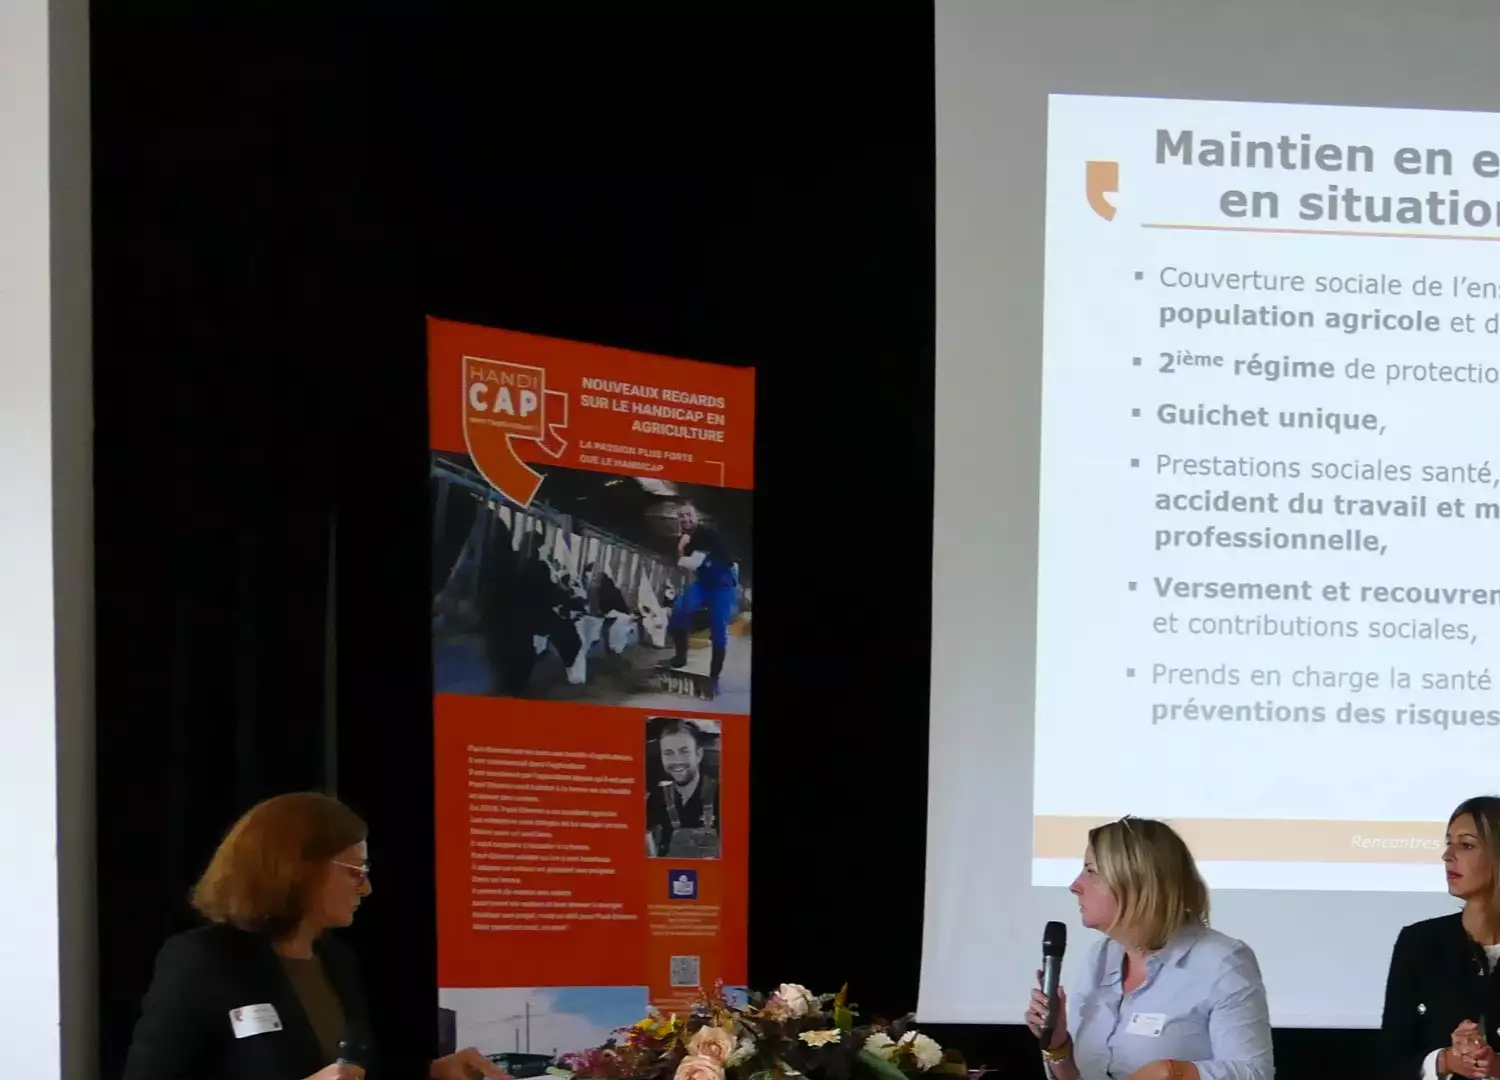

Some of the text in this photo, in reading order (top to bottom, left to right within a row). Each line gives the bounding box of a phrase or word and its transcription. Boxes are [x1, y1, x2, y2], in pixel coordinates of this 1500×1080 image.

[1155, 129, 1374, 173] Maintien
[1393, 147, 1453, 176] en
[1219, 189, 1279, 219] en
[1159, 266, 1305, 292] Couverture
[1315, 273, 1402, 296] sociale
[1412, 275, 1443, 297] de
[1159, 303, 1314, 330] population
[1325, 308, 1440, 335] agricole
[1450, 313, 1475, 334] et
[470, 366, 538, 389] HANDI
[1234, 352, 1335, 382] régime
[1345, 357, 1375, 380] de
[469, 382, 538, 417] CAP
[582, 376, 726, 409] NOUVEAUX REGARDS
[580, 394, 726, 426] SUR LE HANDICAP EN
[1157, 403, 1386, 436] Guichet unique,
[631, 419, 725, 442] AGRICULTURE
[663, 451, 694, 462] FORTE
[1157, 454, 1301, 479] Prestations
[1311, 459, 1412, 482] sociales
[1421, 460, 1500, 489] santé,
[1155, 489, 1279, 514] accident
[1288, 492, 1323, 515] du
[1333, 494, 1427, 518] travail
[1436, 498, 1466, 519] et
[1155, 525, 1387, 556] professionnelle,
[1153, 576, 1313, 601] Versement
[1322, 581, 1351, 602] et
[1153, 613, 1477, 645] et contributions sociales,
[1153, 663, 1240, 686] Prends
[1250, 669, 1281, 686] en
[1292, 666, 1379, 693] charge
[1391, 668, 1410, 689] la
[1422, 670, 1492, 691] santé
[1152, 697, 1326, 725] préventions
[1336, 701, 1385, 724] des
[1396, 703, 1500, 731] risques
[1350, 835, 1440, 851] Rencontres
